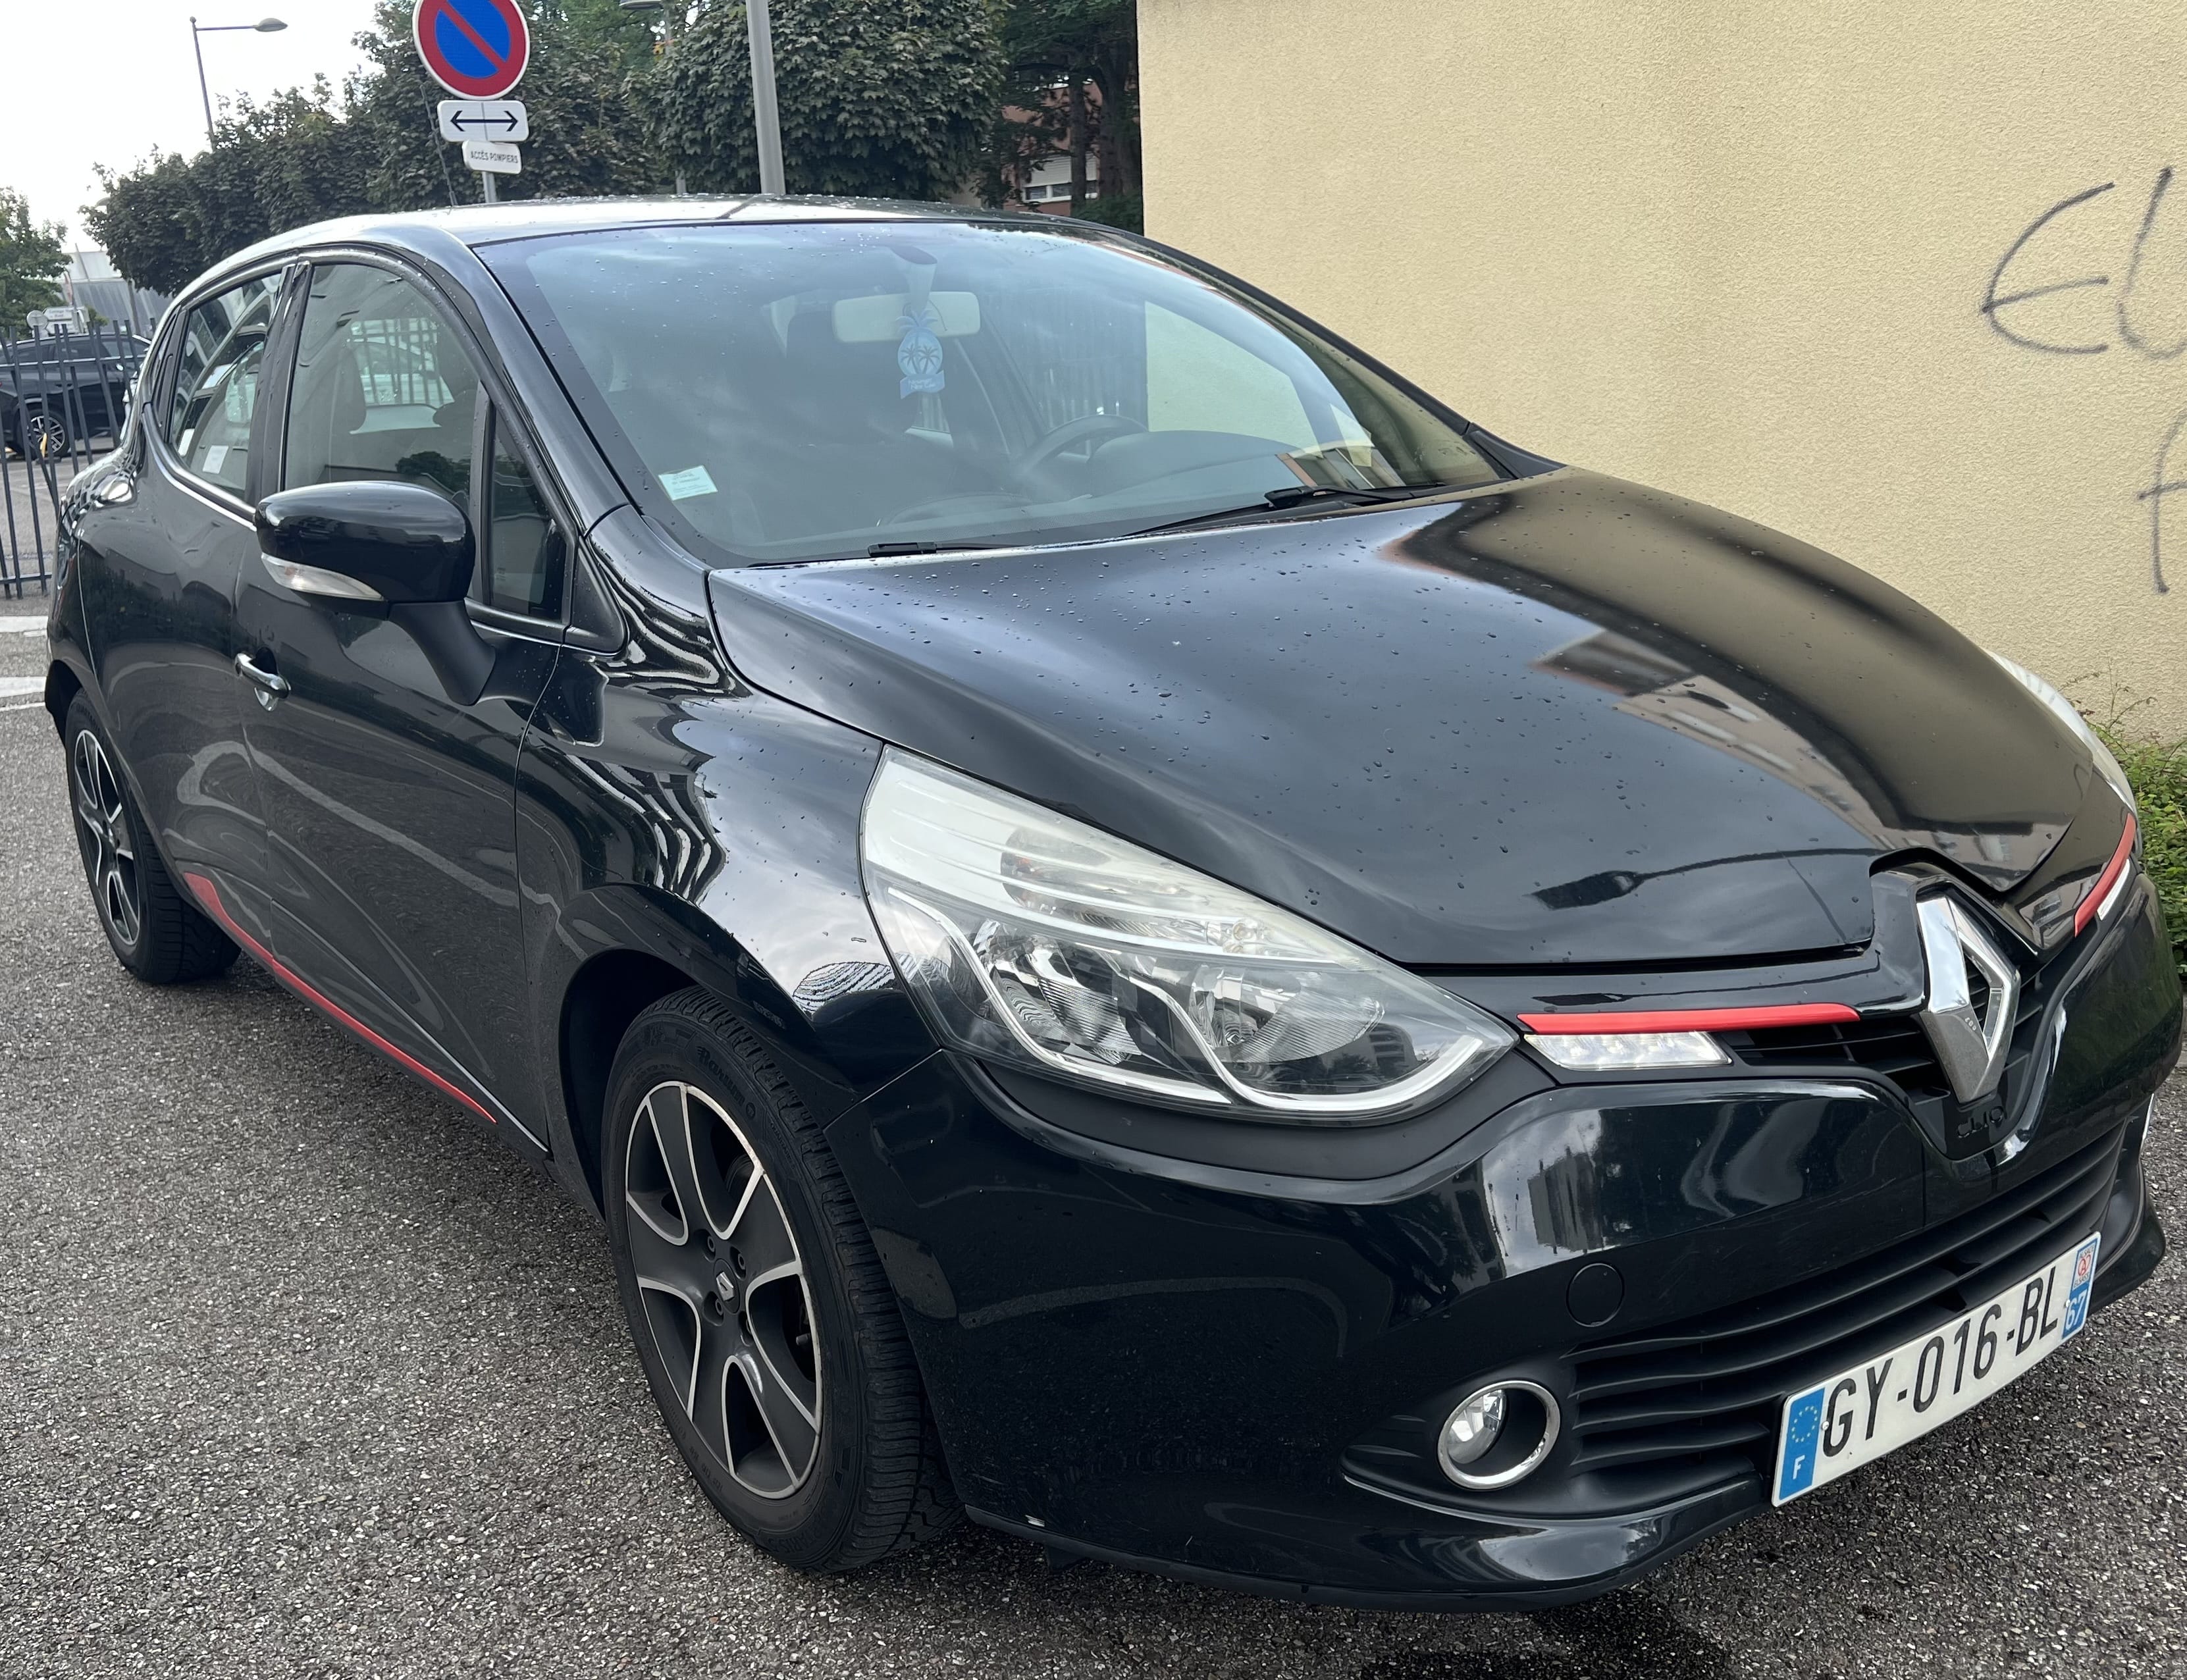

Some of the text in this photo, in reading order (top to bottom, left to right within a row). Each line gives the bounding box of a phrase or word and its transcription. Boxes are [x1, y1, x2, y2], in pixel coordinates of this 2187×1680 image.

[471, 150, 518, 163] ACCÈS POMPIERS
[695, 1045, 745, 1107] Barum
[1957, 1105, 2005, 1139] CLIO
[2066, 1290, 2087, 1330] 67
[1792, 1266, 2058, 1480] F GY-016-BL
